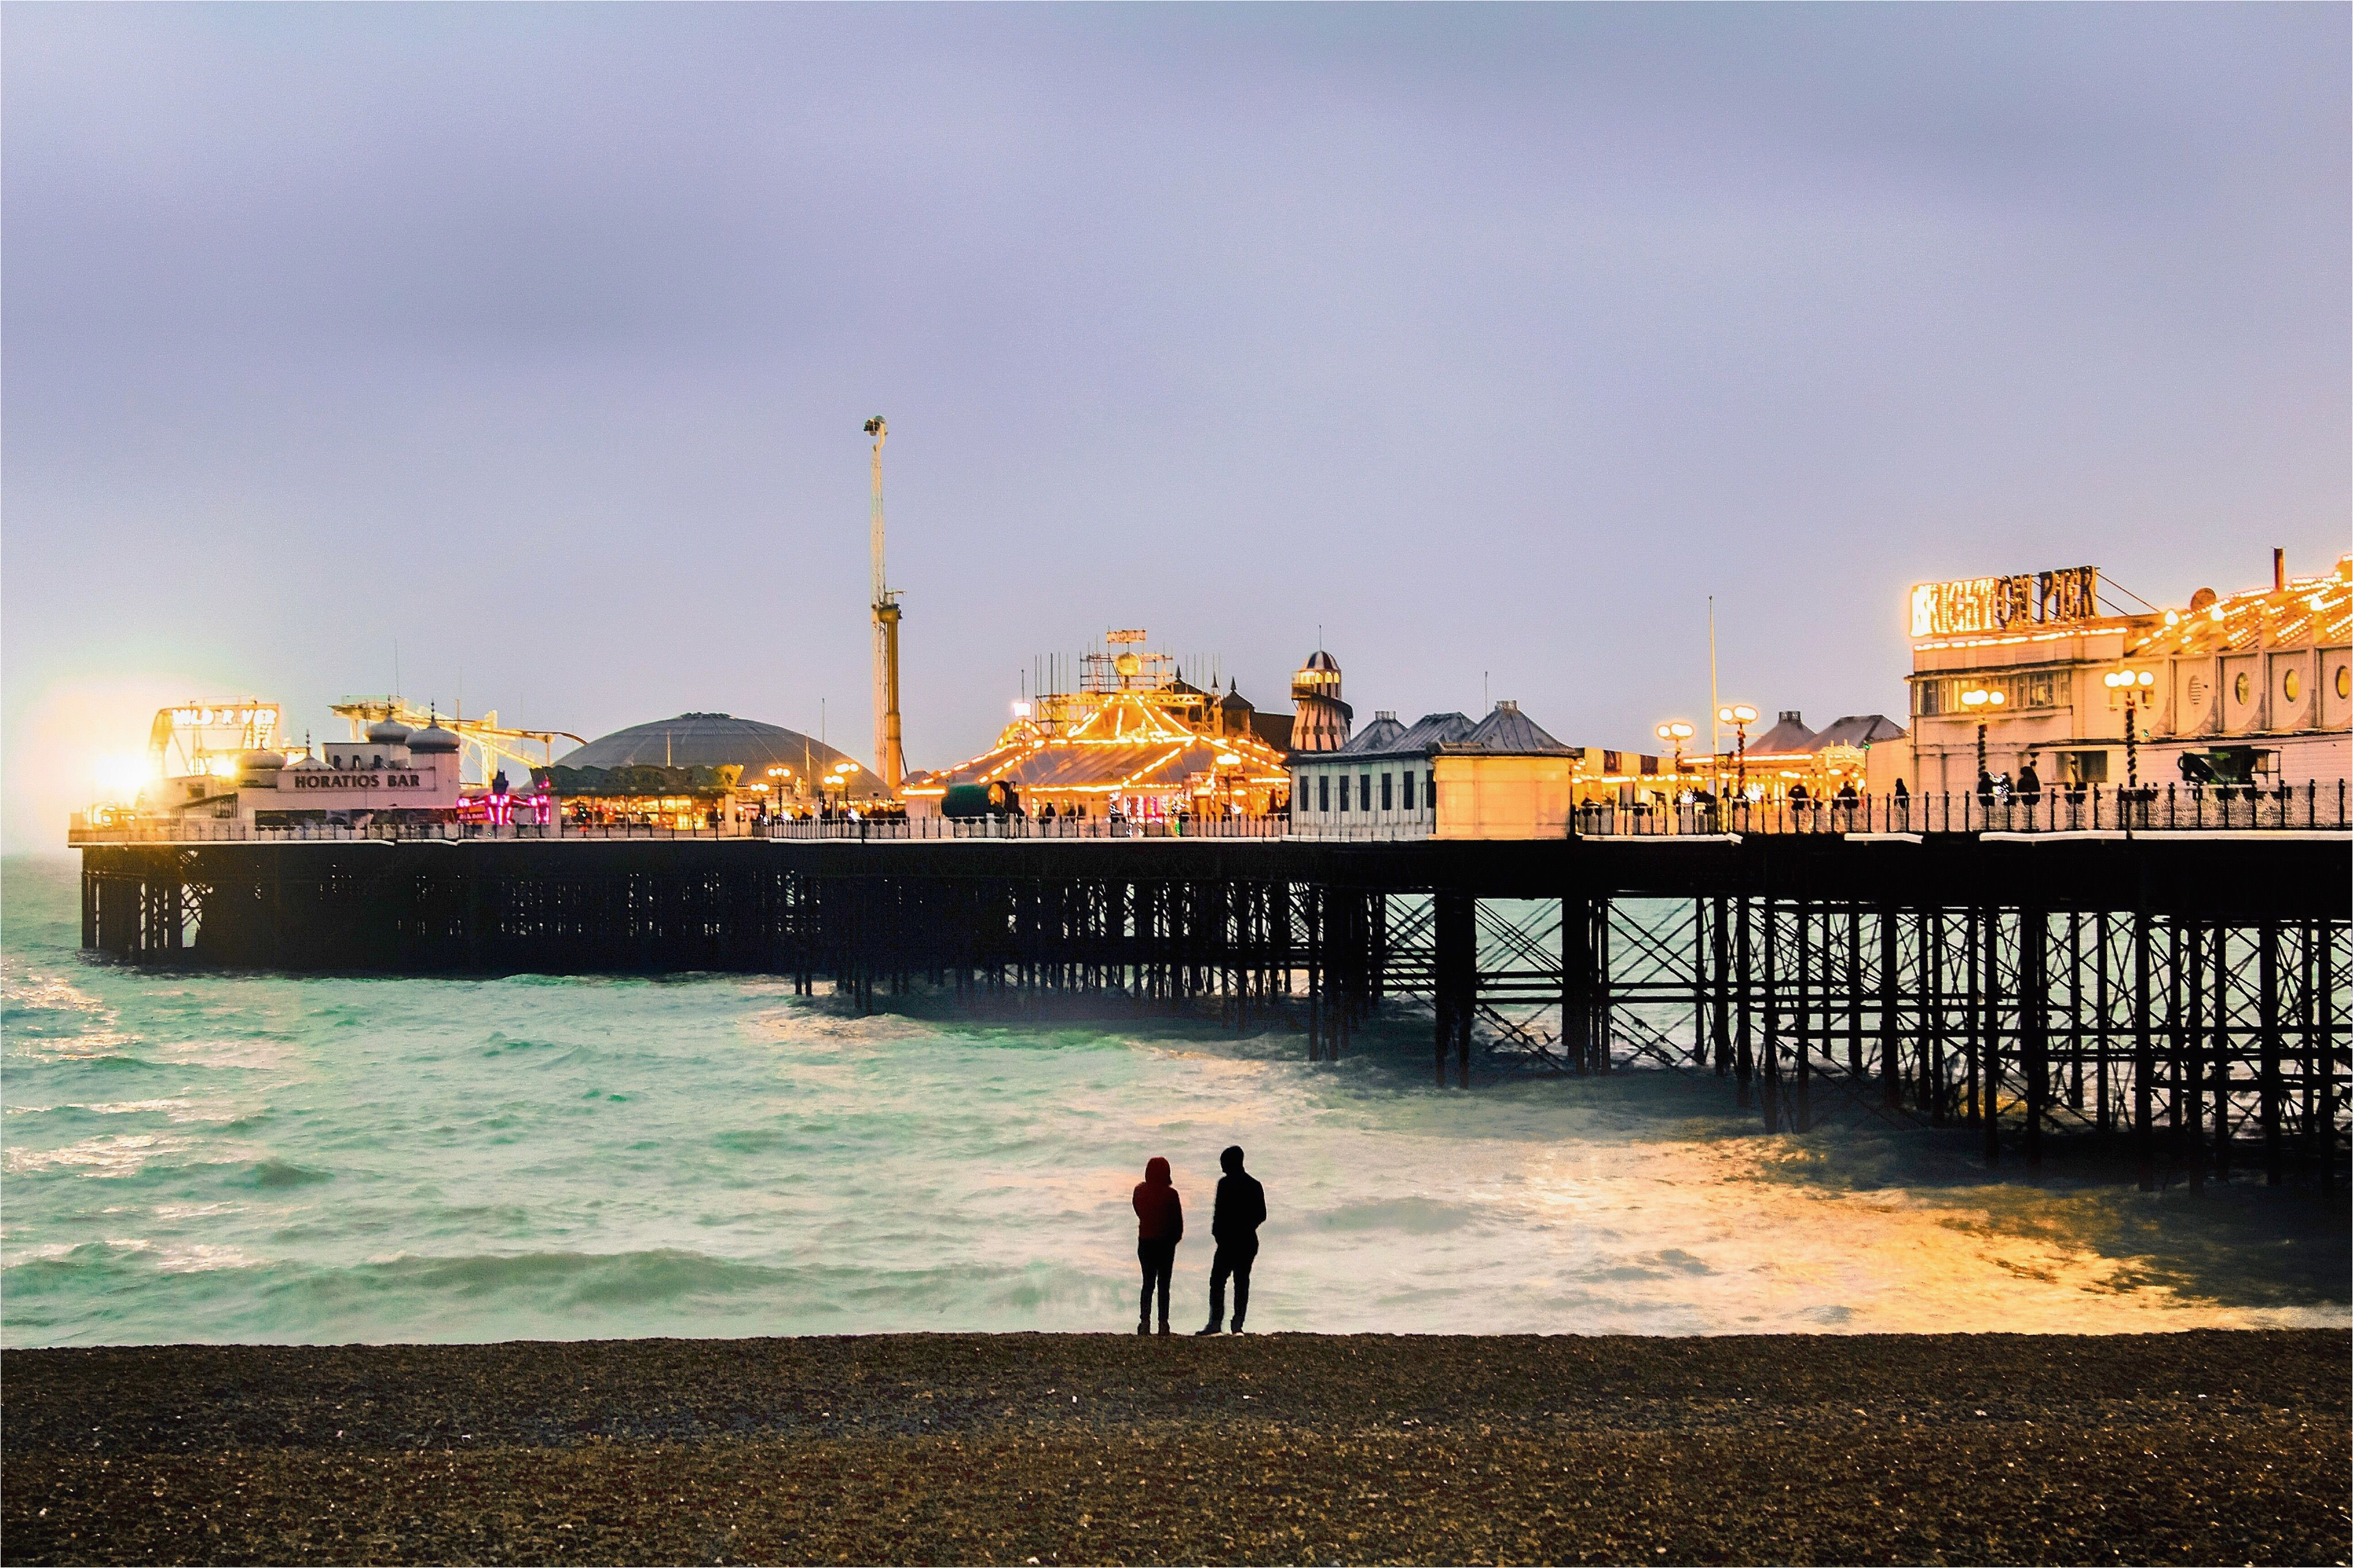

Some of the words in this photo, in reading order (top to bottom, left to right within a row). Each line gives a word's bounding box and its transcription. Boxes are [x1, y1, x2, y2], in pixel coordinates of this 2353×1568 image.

[1910, 574, 2032, 637] BRIGHTON
[2039, 565, 2097, 624] PIER
[294, 774, 380, 788] HORATIOS
[387, 774, 420, 787] BAR
